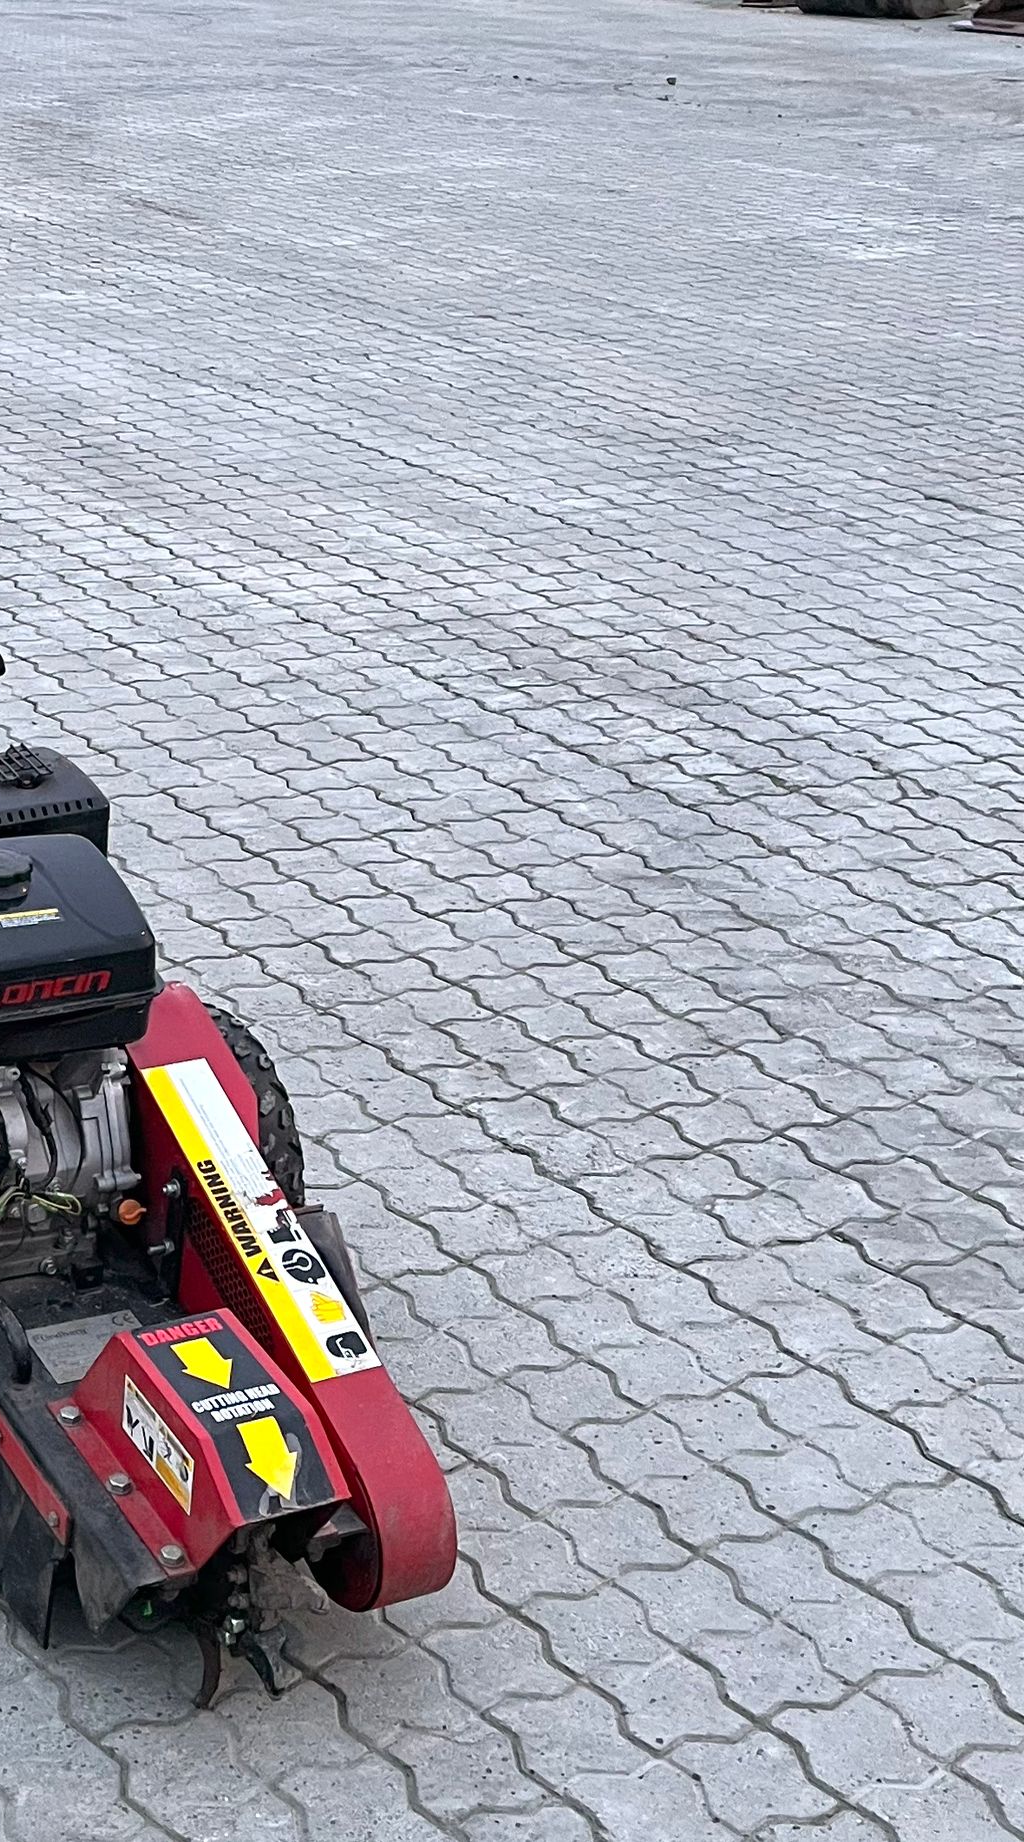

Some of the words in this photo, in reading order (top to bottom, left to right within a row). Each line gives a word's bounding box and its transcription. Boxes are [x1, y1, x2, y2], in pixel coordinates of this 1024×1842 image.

[197, 1159, 262, 1258] WARNING
[140, 1317, 223, 1347] DANGER
[191, 1391, 249, 1414] CUTTING
[243, 1383, 281, 1401] HEAD
[210, 1398, 276, 1423] ROTATION
